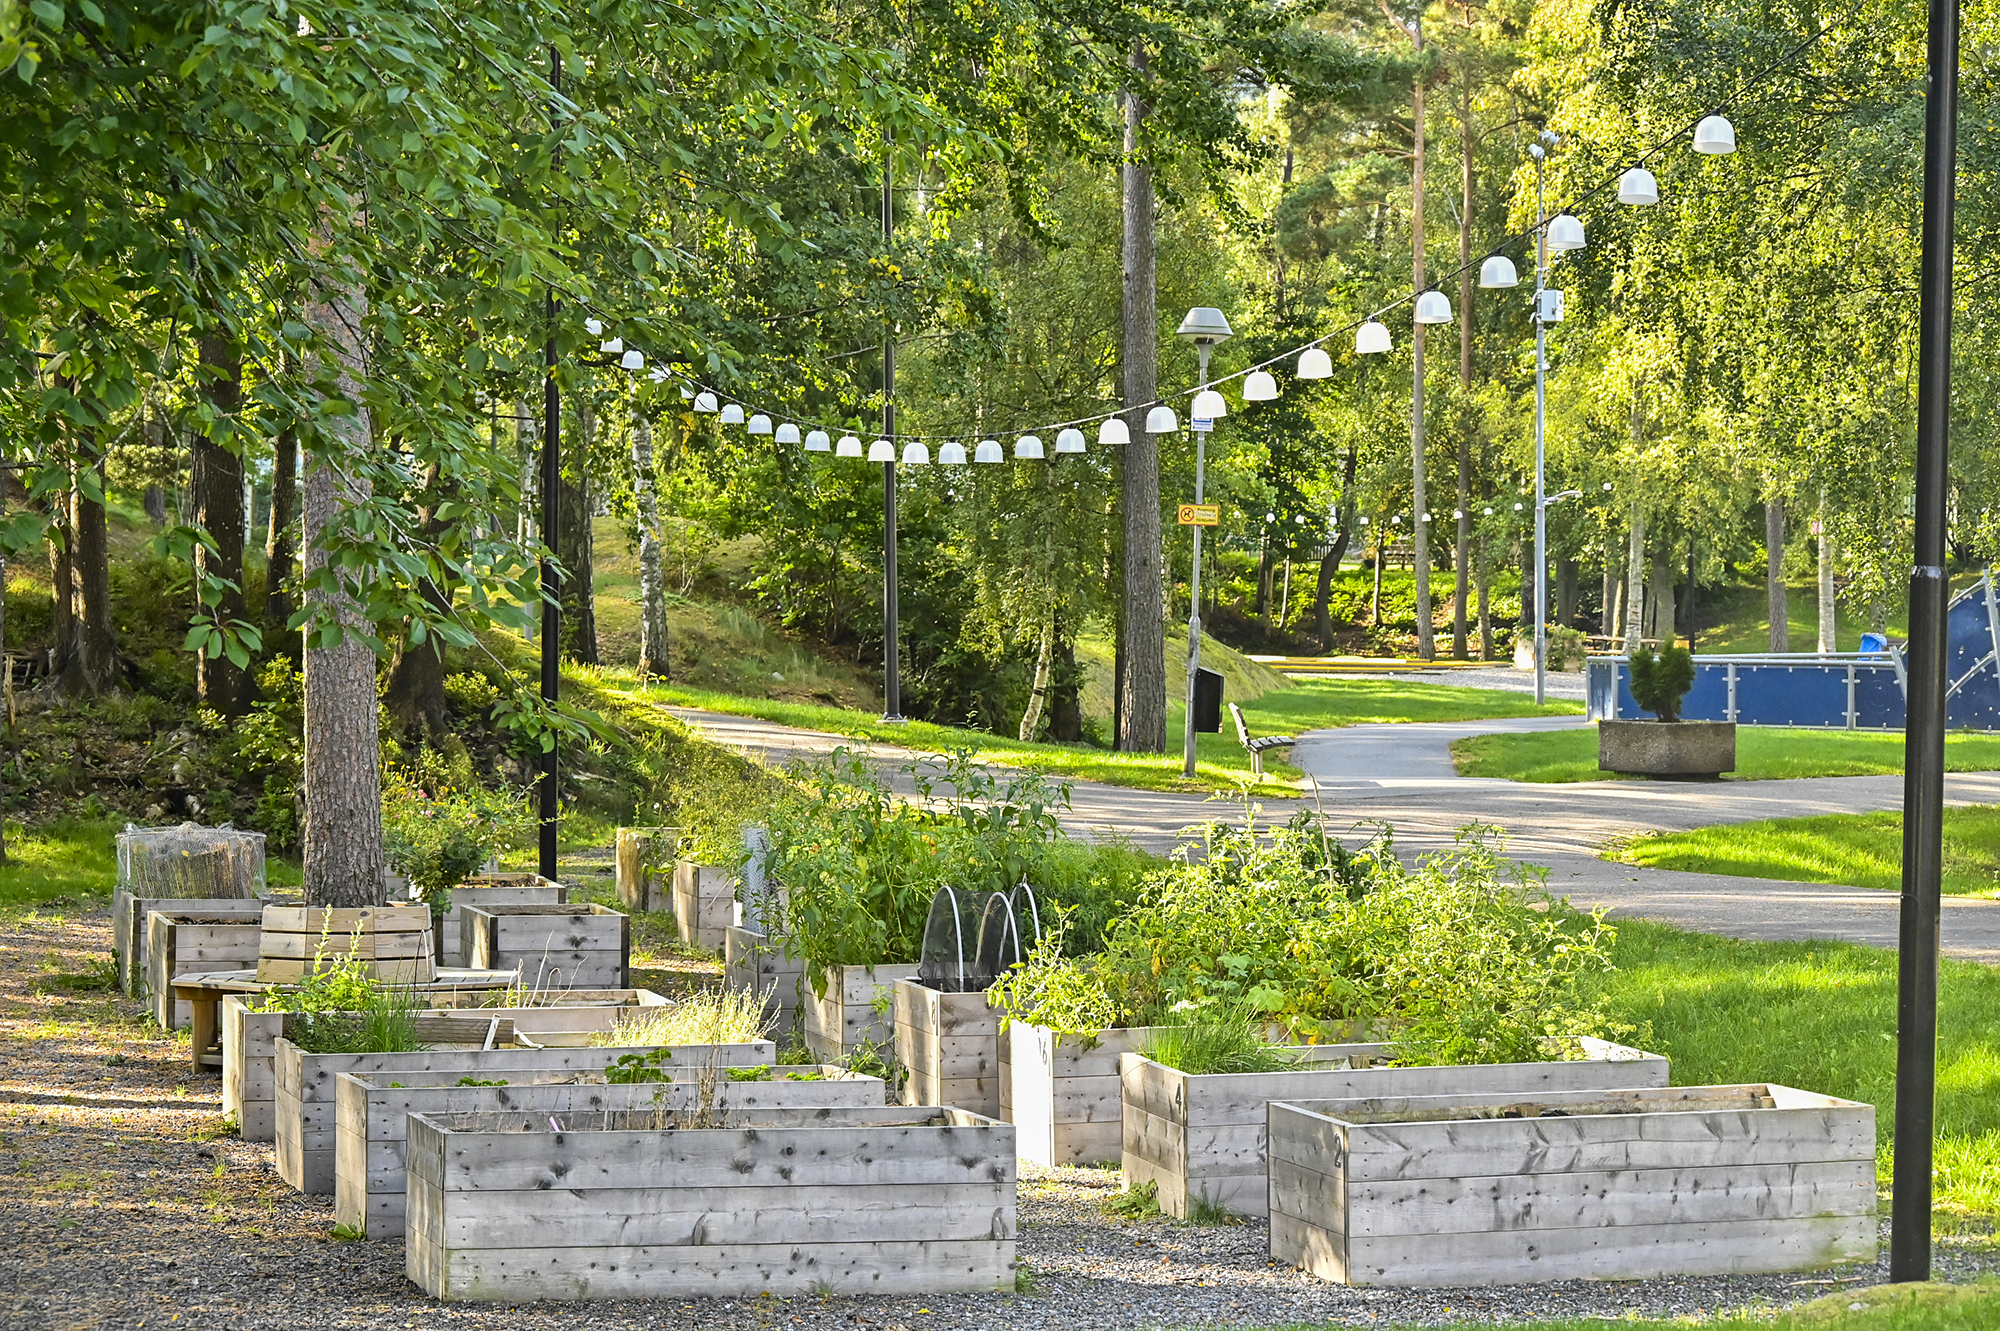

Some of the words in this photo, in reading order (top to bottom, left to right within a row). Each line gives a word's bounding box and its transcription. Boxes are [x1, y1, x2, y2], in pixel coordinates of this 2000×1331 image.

[931, 1000, 936, 1025] 8
[1175, 1083, 1182, 1114] 4
[1334, 1133, 1342, 1168] 2
